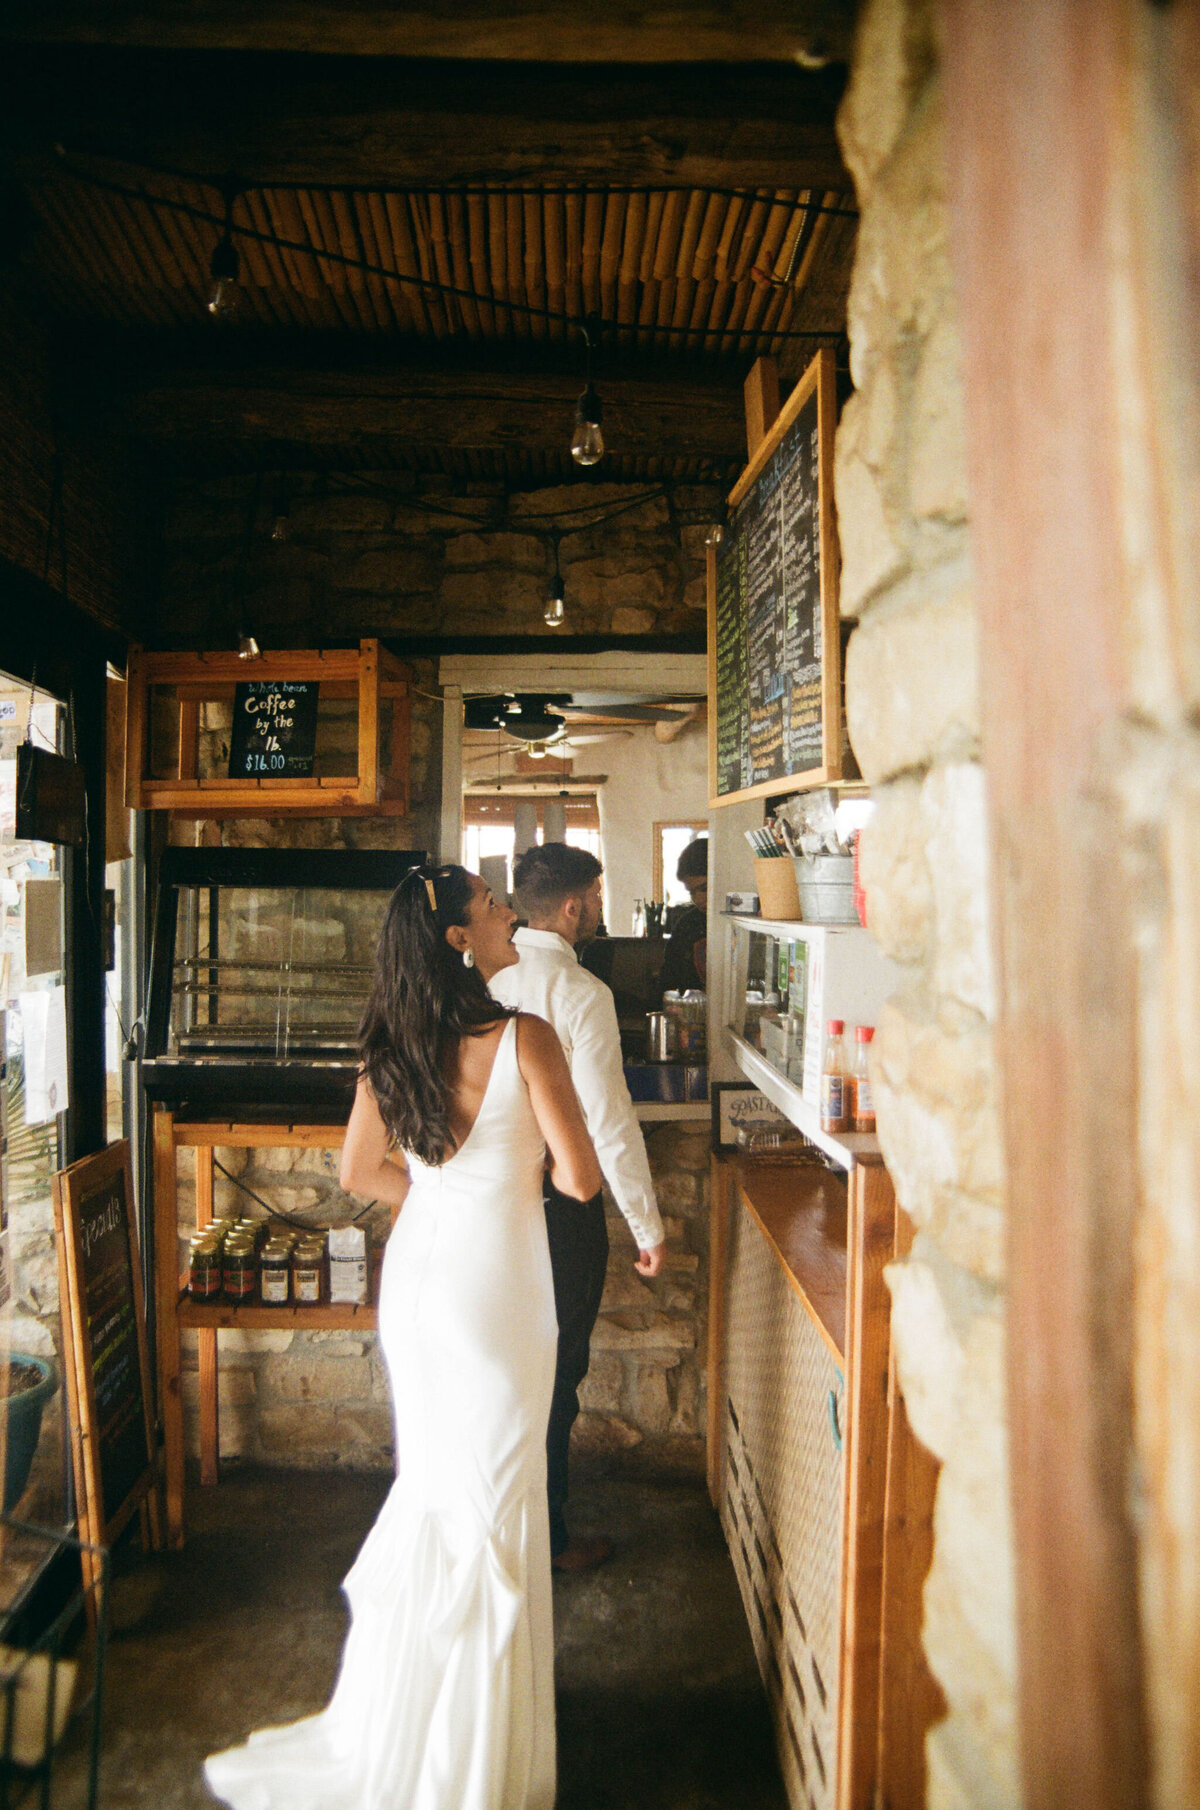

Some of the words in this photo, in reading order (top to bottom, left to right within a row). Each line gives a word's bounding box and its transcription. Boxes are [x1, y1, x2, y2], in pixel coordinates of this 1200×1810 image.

[244, 693, 296, 716] Coffee
[255, 718, 270, 735] by
[274, 714, 294, 728] the
[245, 754, 286, 771] $16.00
